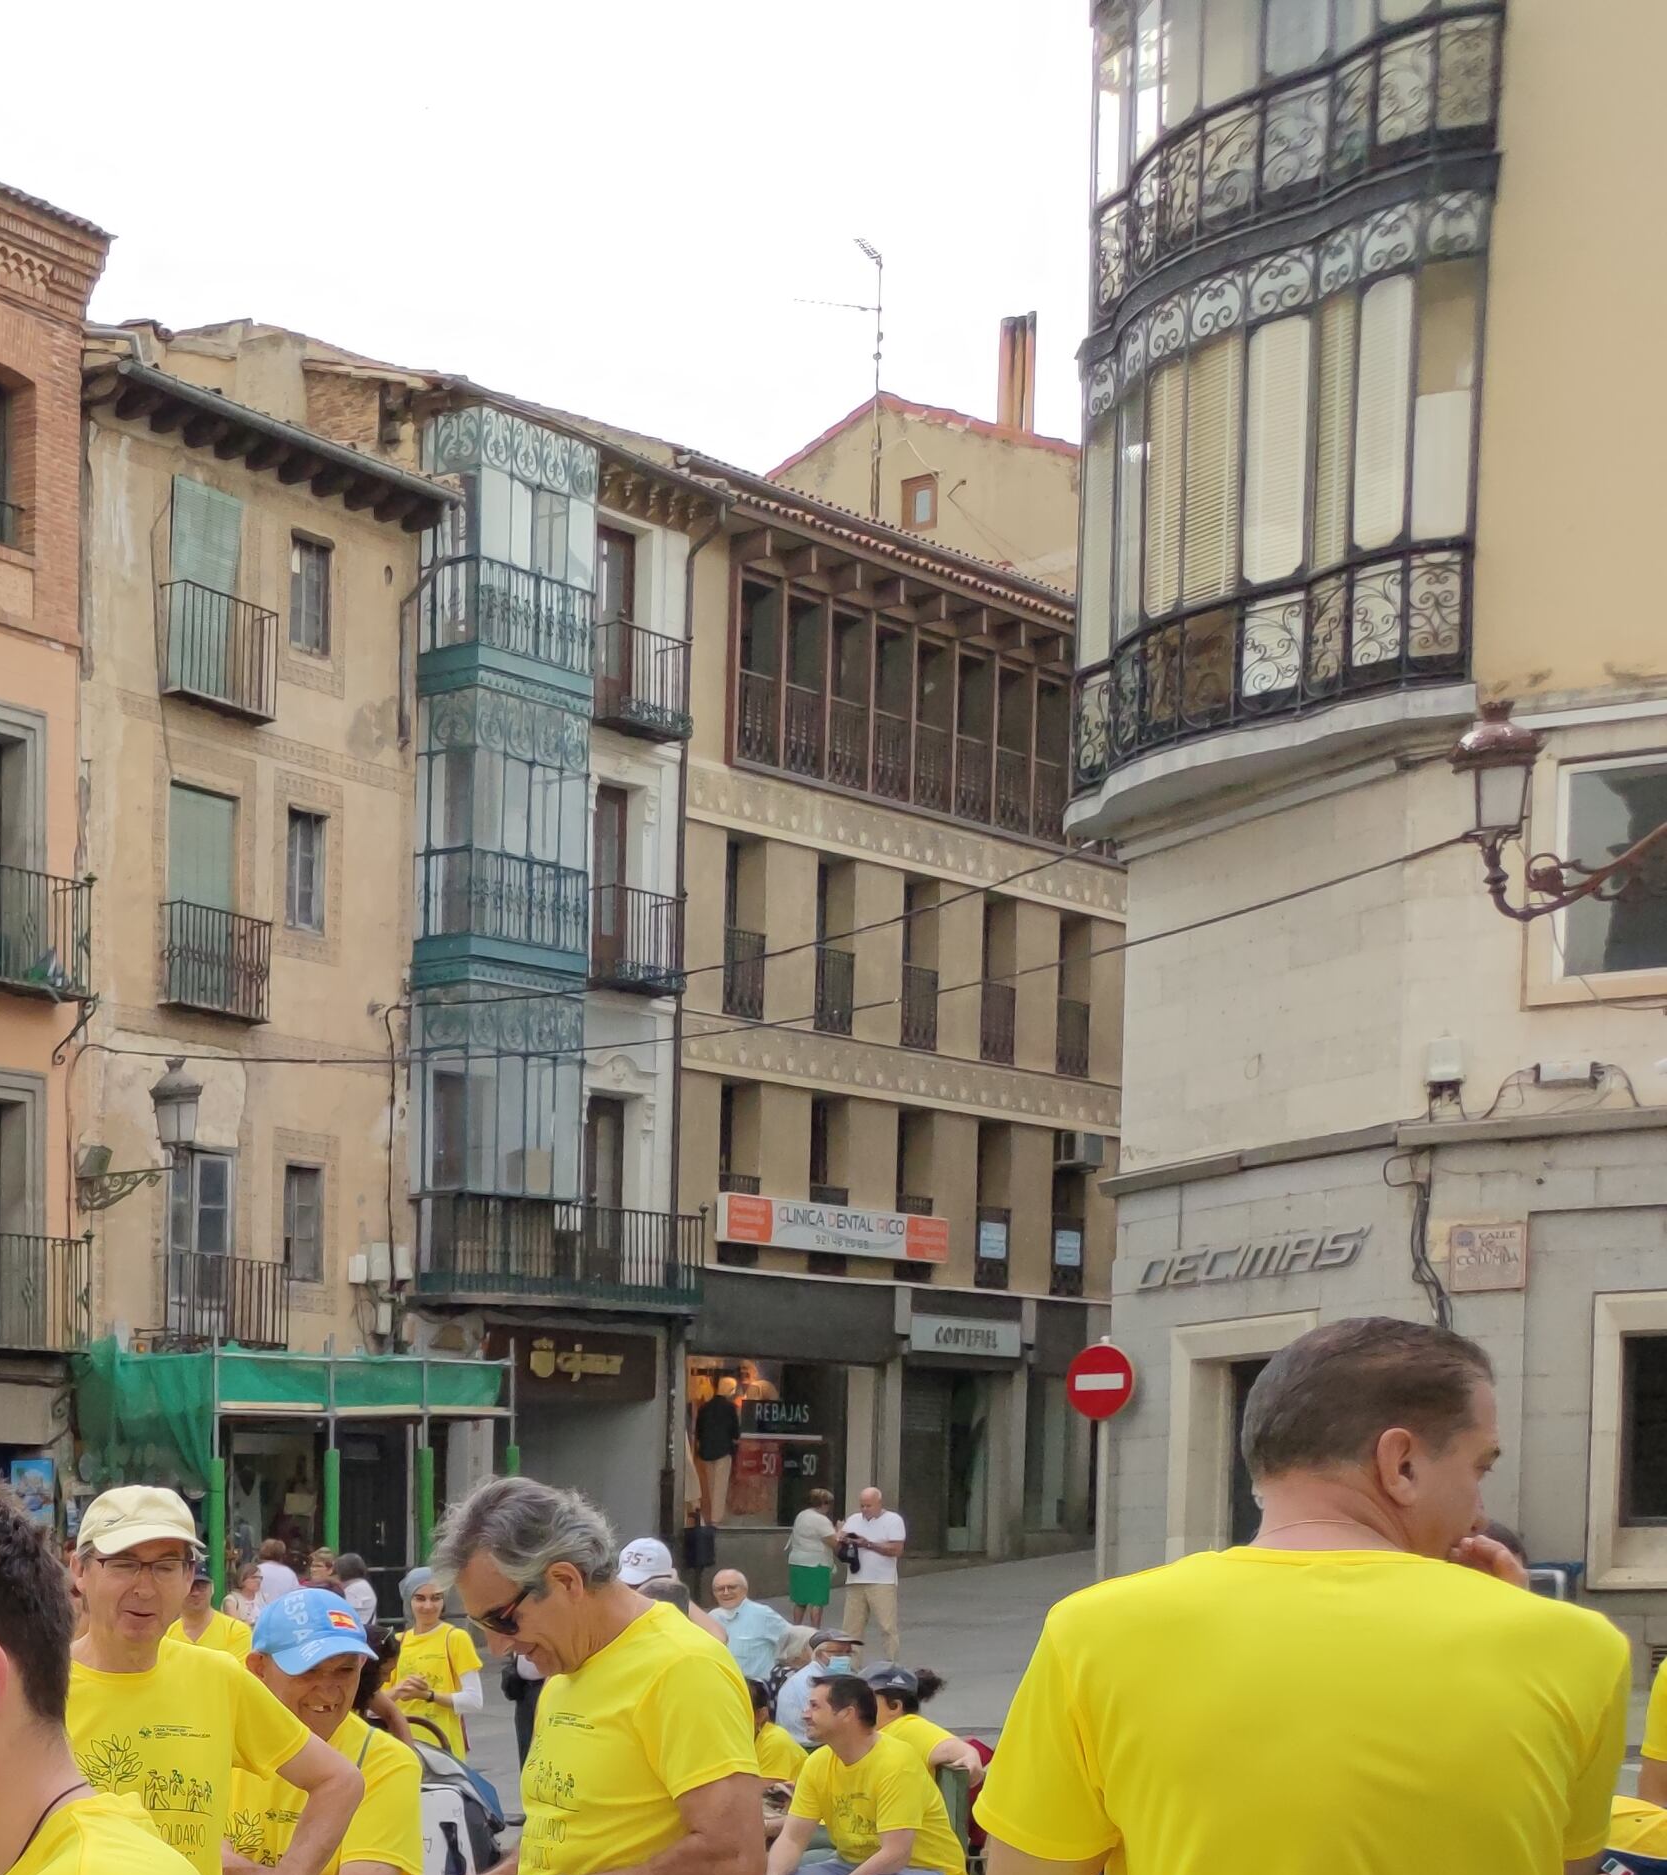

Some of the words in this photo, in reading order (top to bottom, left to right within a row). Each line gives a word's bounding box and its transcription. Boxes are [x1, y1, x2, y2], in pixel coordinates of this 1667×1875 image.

[828, 1212, 874, 1232] DENTAL
[1137, 1223, 1372, 1290] DECIMAS
[755, 1402, 810, 1423] REBAJAS
